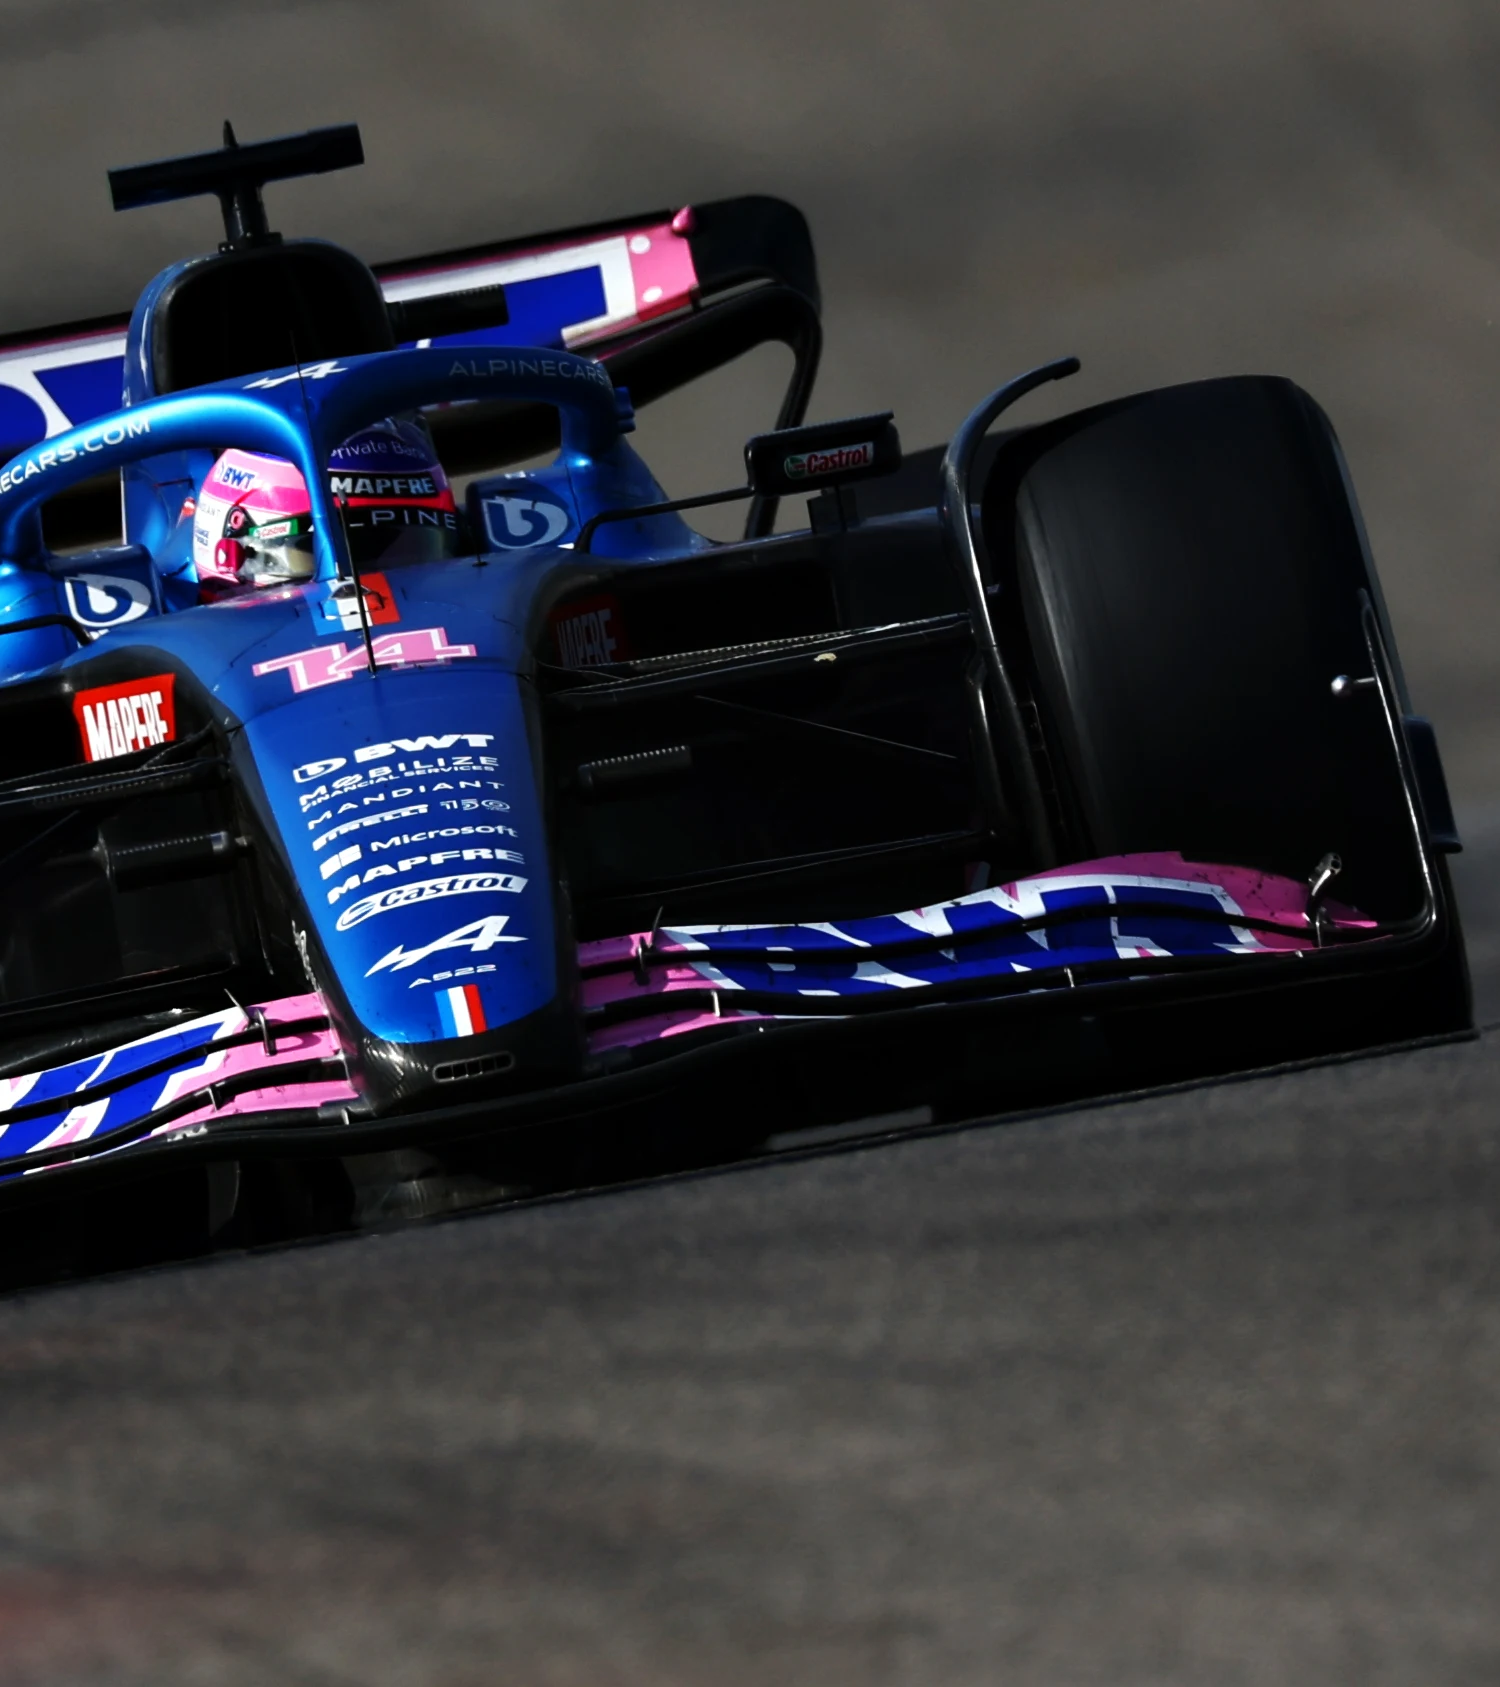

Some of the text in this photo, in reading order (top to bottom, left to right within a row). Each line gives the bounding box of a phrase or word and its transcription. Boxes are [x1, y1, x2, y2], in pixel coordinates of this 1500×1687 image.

[807, 444, 869, 474] Castrol
[222, 467, 255, 489] BWT
[331, 476, 436, 495] MAPFRE
[252, 627, 477, 693] 14
[82, 691, 168, 762] MAPFRE
[354, 734, 494, 763] BWT
[302, 766, 495, 812] FINANCIAL SERVICES
[308, 780, 504, 830] MANDIANT
[370, 824, 518, 852] Microsoft
[327, 848, 525, 904] MAPFRE
[379, 877, 514, 908] Castrol
